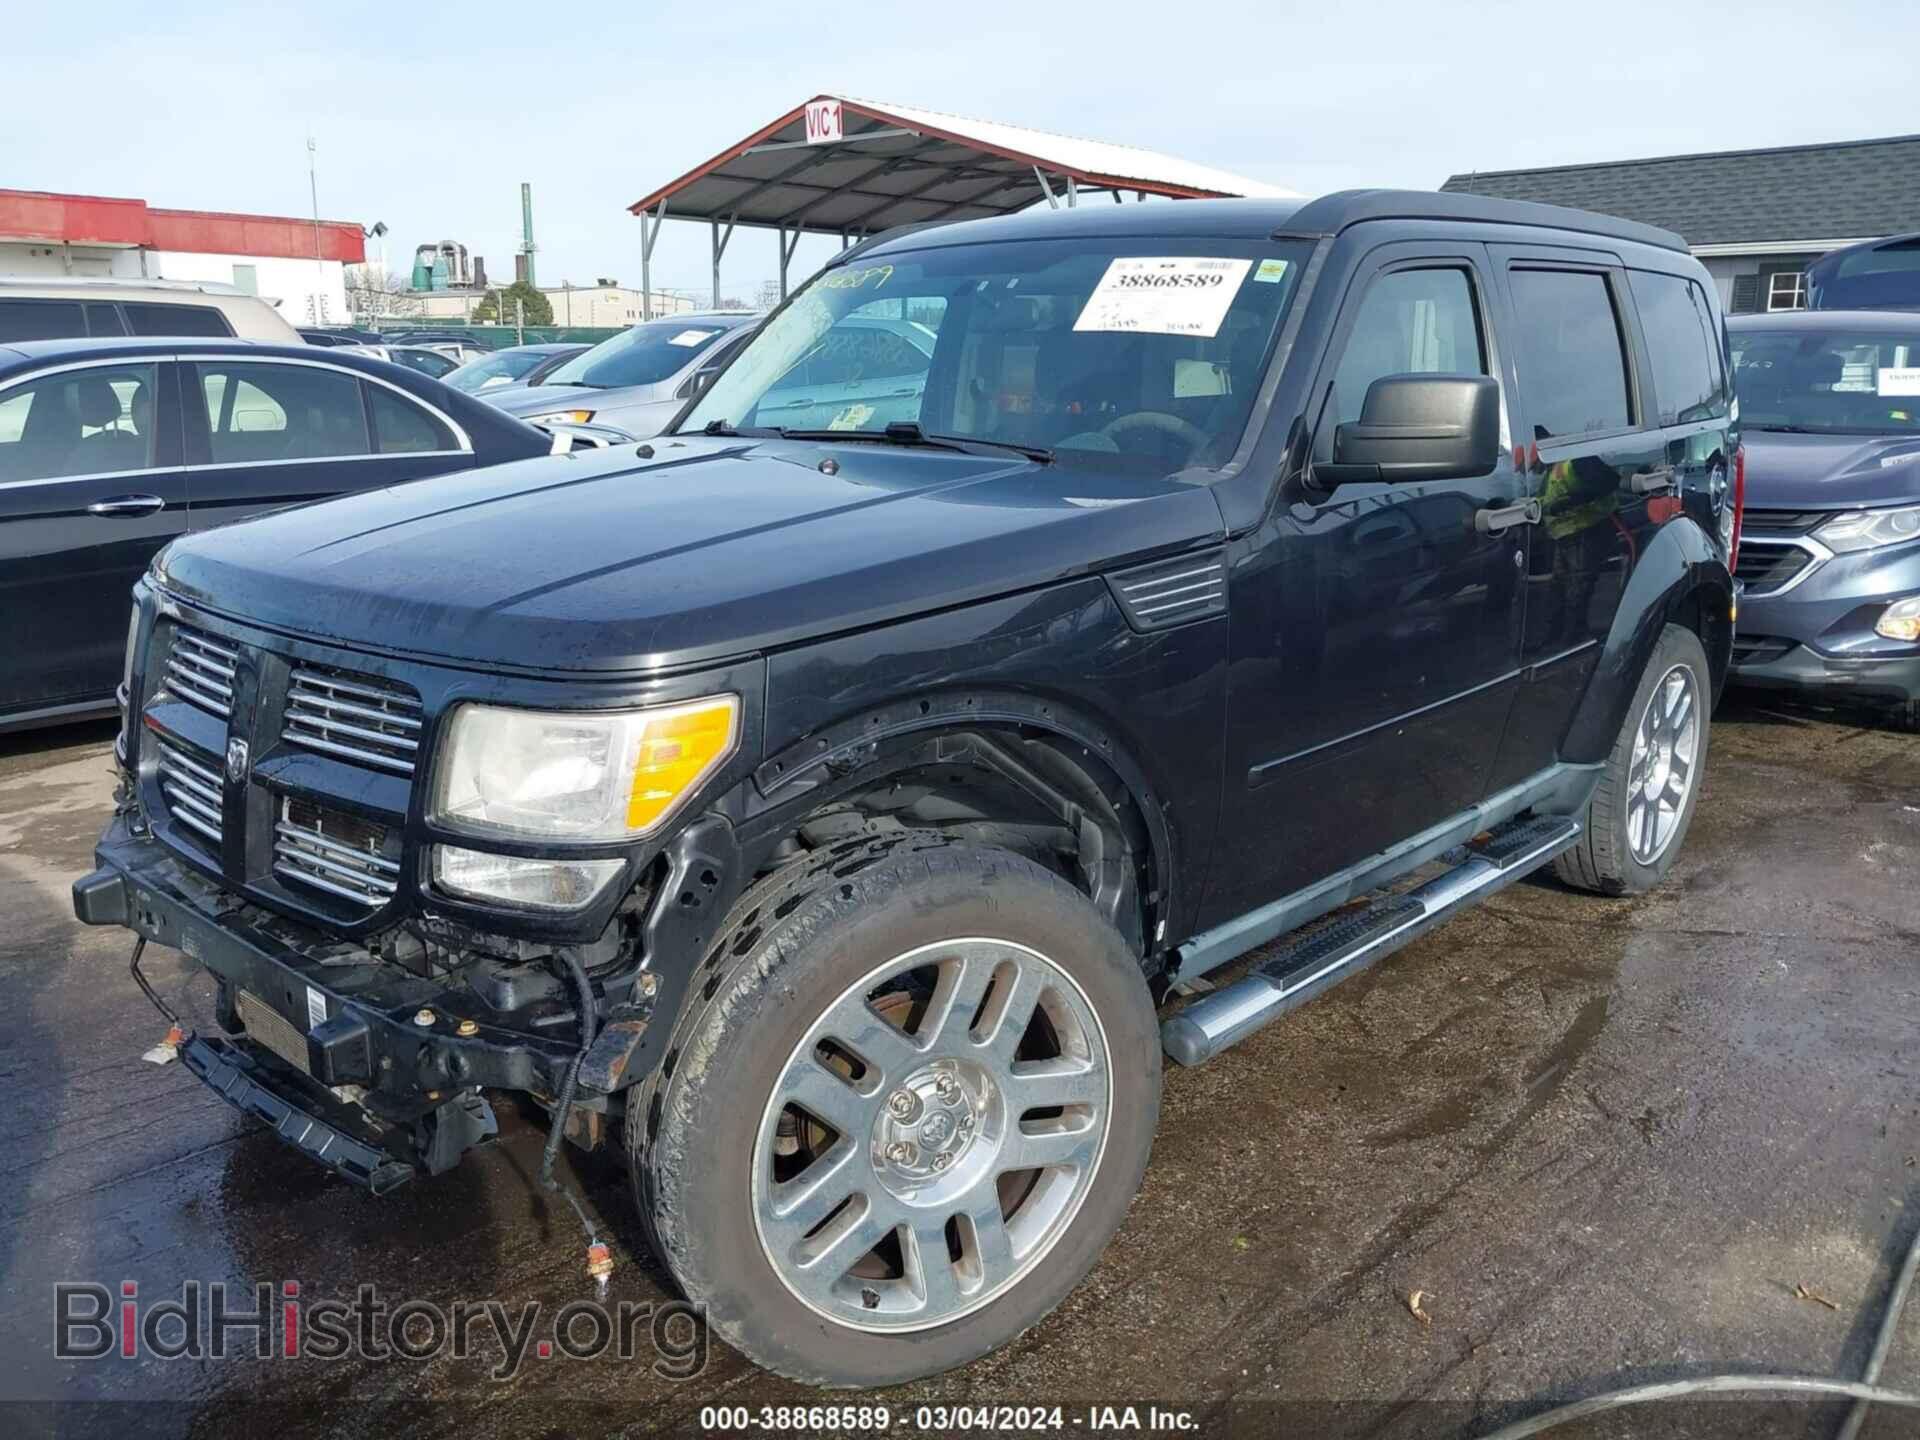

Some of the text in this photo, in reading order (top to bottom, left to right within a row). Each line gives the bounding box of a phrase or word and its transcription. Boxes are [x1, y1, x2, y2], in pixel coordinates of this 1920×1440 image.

[807, 104, 841, 137] VIC 1
[1112, 273, 1224, 289] 38868589
